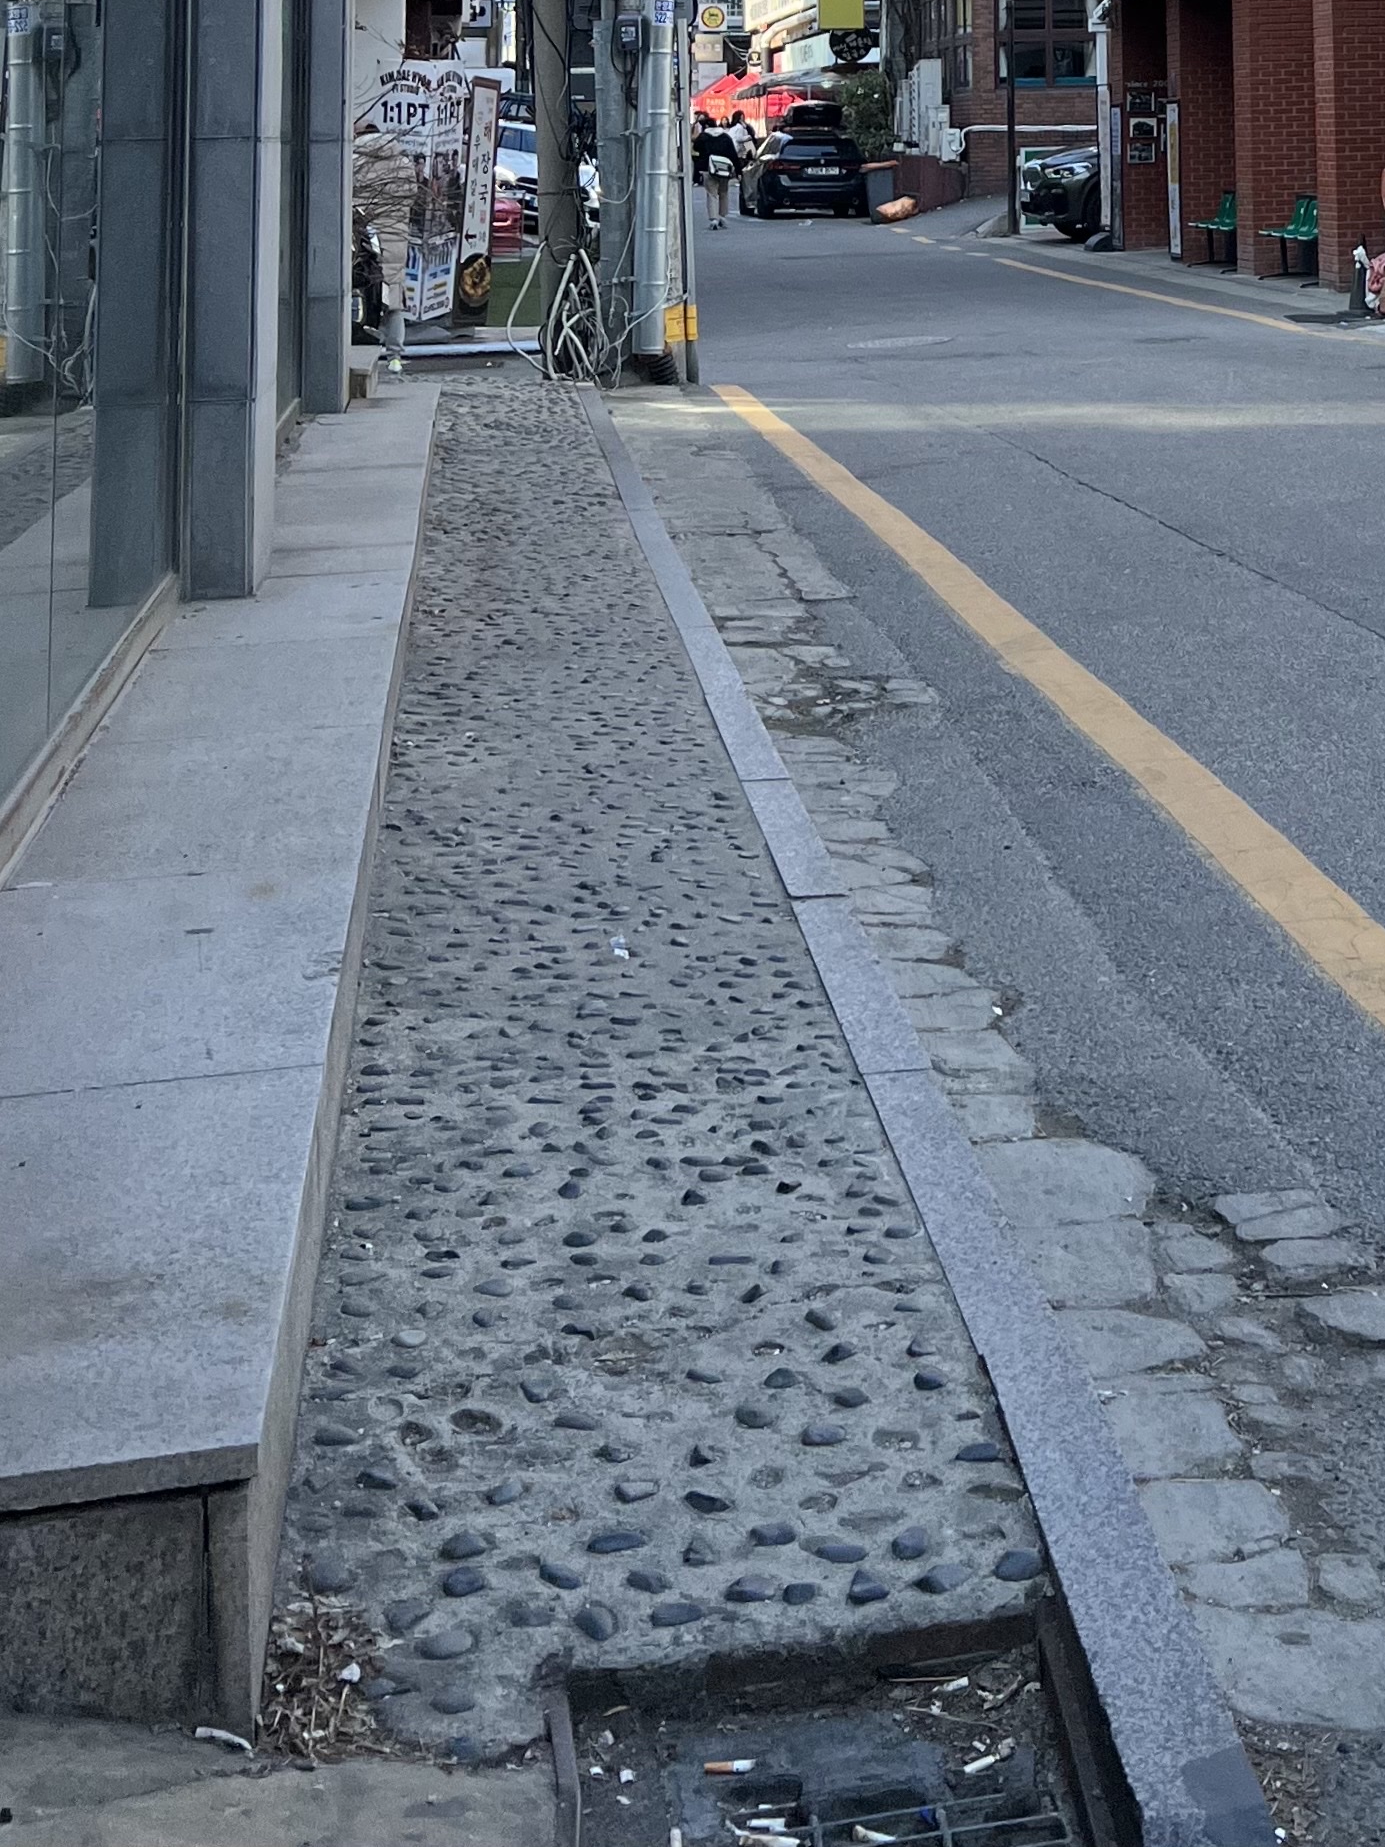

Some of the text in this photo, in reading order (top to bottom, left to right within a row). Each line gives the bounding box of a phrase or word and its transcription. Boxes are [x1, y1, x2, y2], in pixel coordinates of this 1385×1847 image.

[379, 70, 395, 87] KIM
[1152, 79, 1169, 89] 200
[381, 100, 430, 127] 1:1 PT
